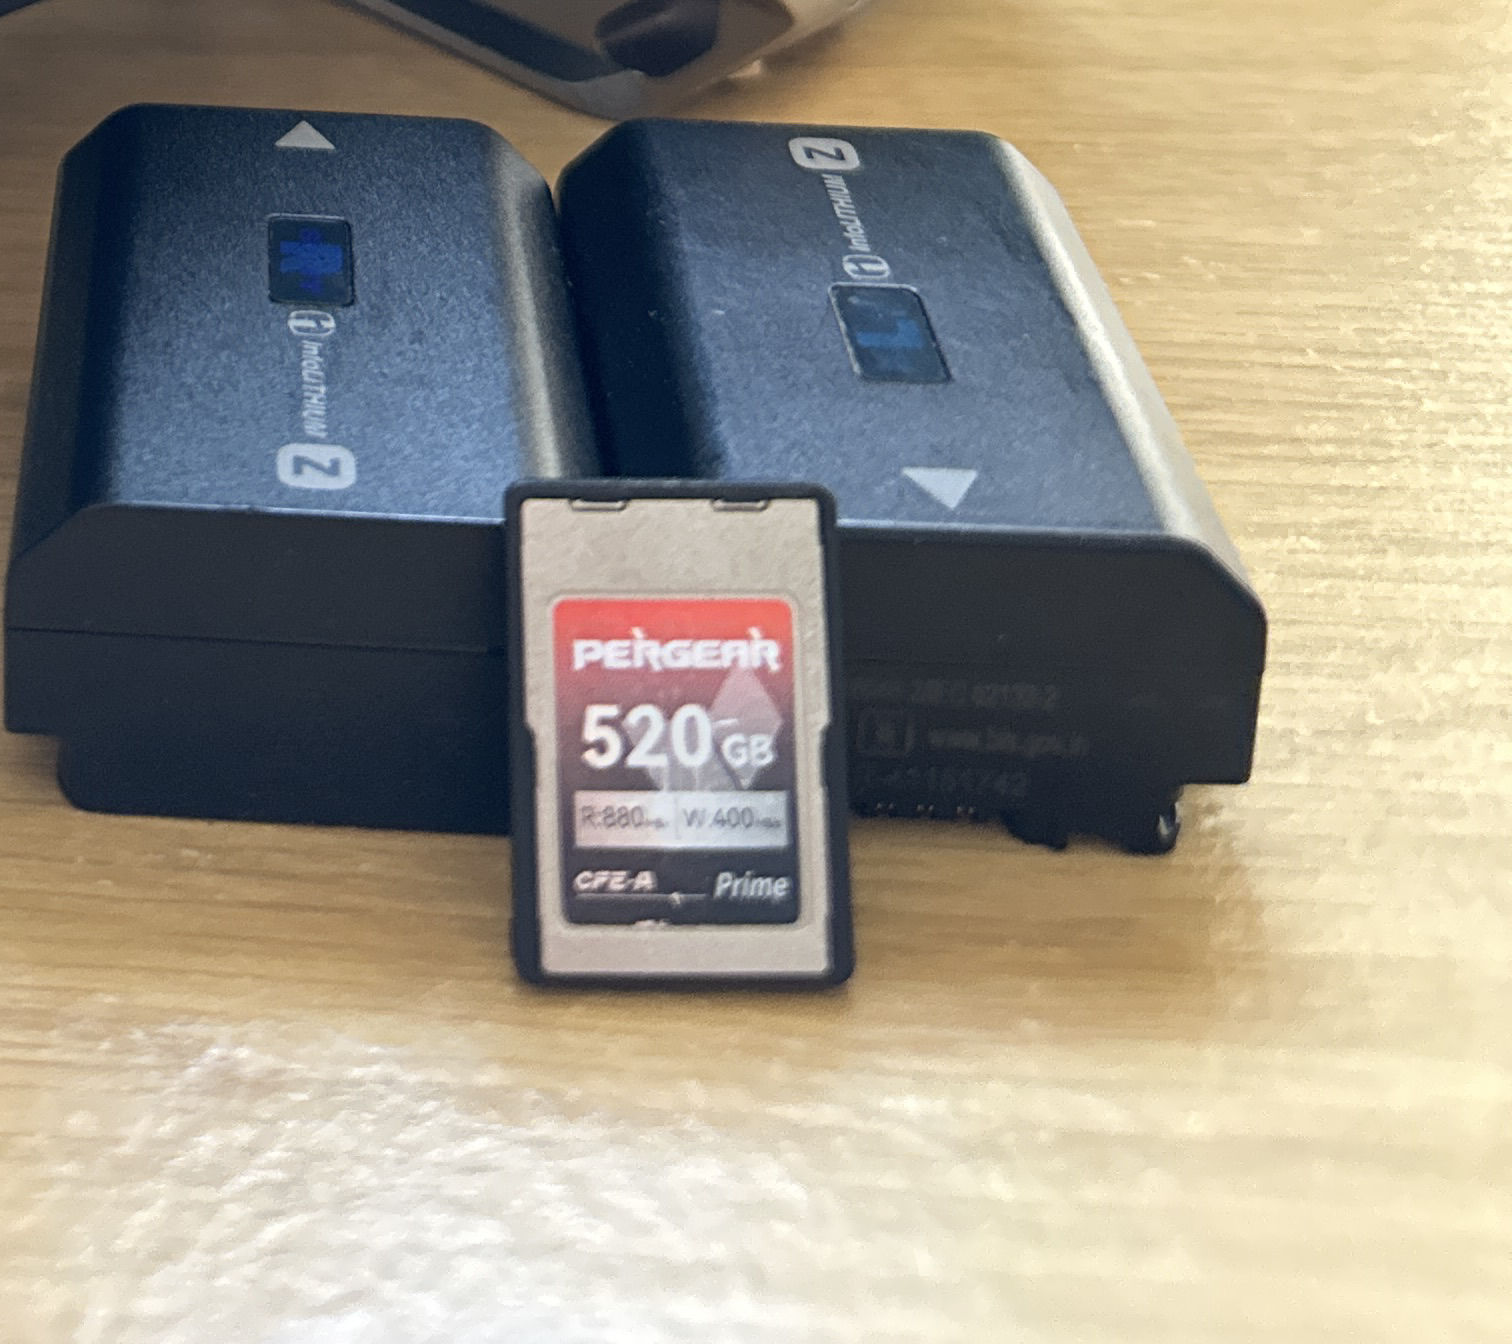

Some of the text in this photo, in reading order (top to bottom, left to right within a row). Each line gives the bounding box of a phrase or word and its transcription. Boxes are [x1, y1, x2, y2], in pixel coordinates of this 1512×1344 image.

[573, 627, 780, 672] PERGEAR
[581, 703, 774, 769] 520 GB
[714, 870, 789, 899] Prime
